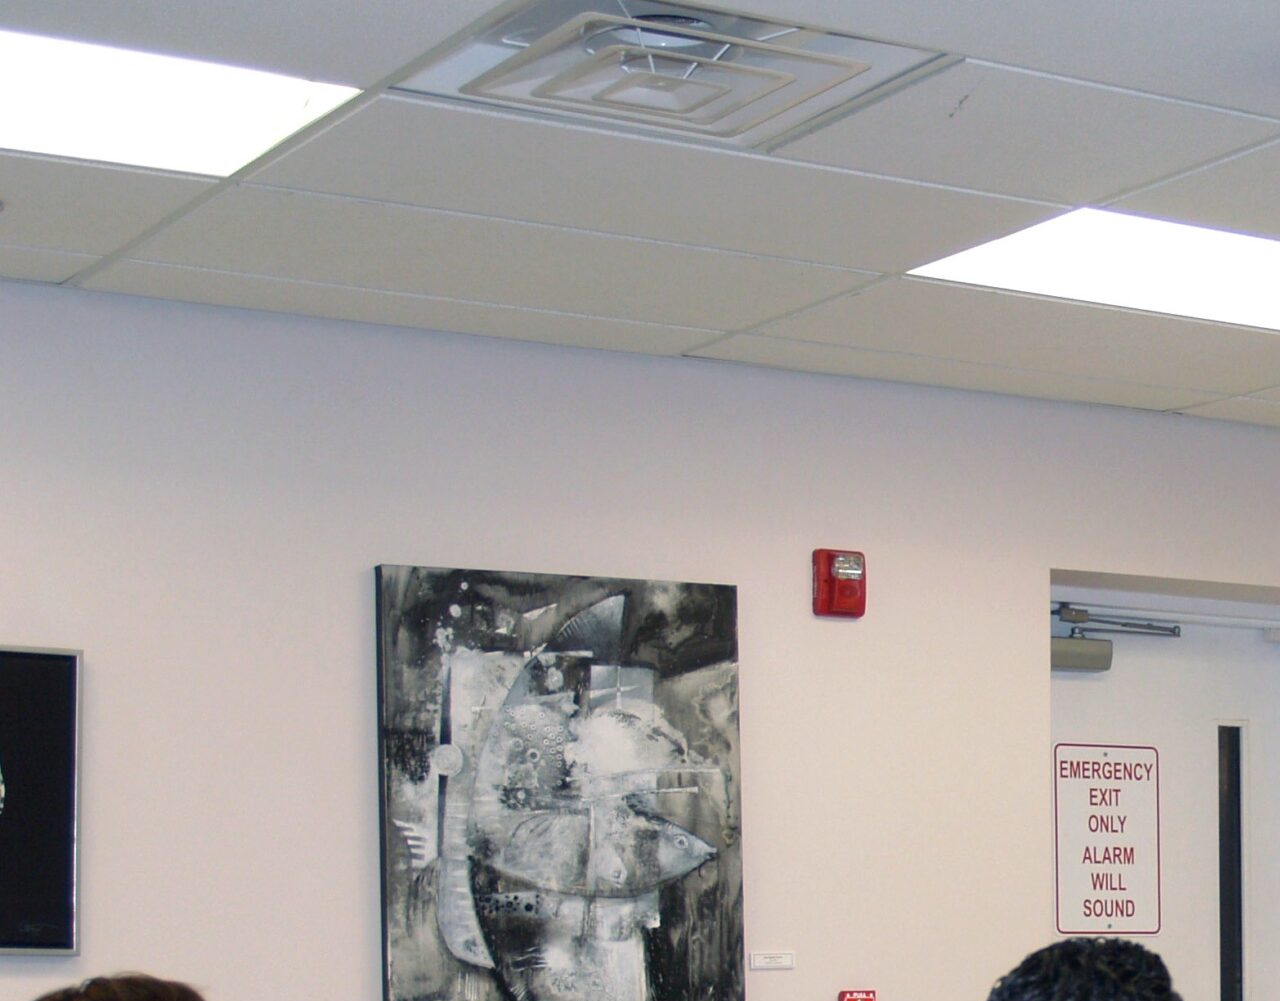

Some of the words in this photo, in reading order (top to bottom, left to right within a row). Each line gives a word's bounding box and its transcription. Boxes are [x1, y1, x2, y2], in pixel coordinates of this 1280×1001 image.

[1059, 760, 1153, 781] EMERGENCY
[1089, 788, 1121, 807] EXIT
[1088, 814, 1127, 834] ONLY
[1082, 846, 1135, 865] ALARM
[1091, 872, 1127, 891] WILL
[1083, 899, 1135, 918] SOUND
